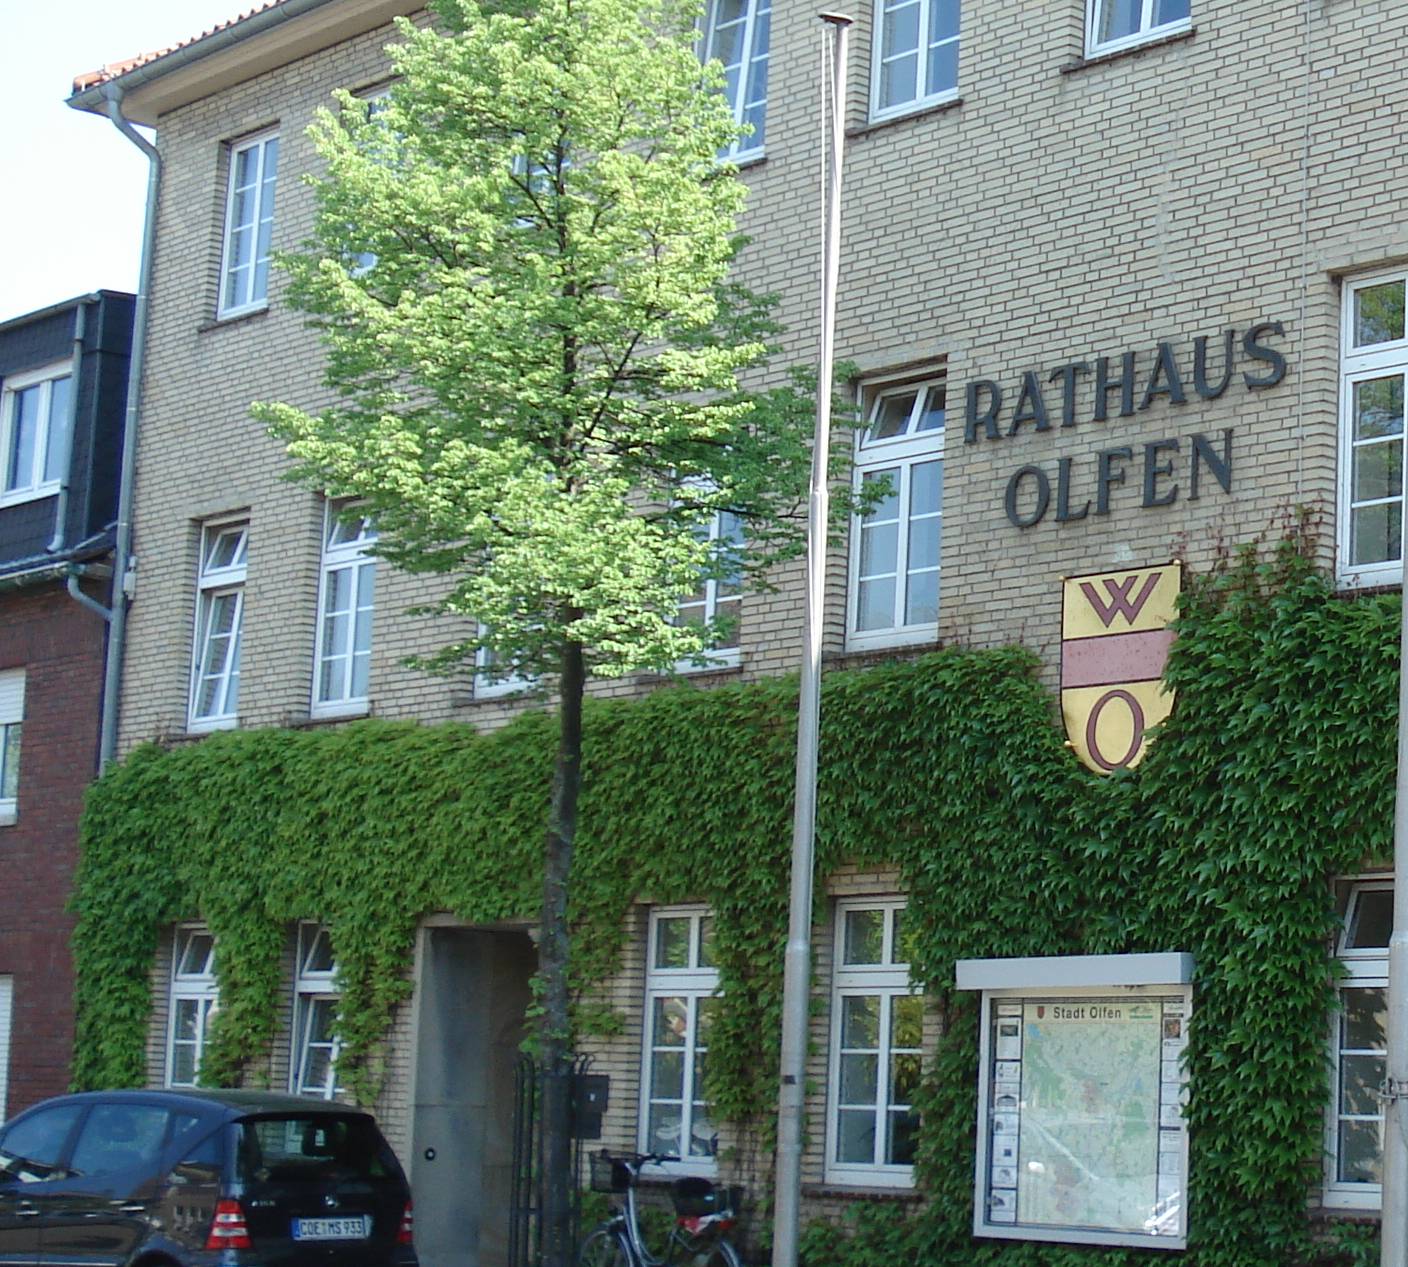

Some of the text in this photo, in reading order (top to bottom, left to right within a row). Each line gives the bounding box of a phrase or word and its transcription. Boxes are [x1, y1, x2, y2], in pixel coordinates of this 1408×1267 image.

[963, 320, 1288, 445] RATHAUS
[1004, 427, 1234, 528] OLFEN
[1079, 572, 1162, 628] W
[1053, 1006, 1121, 1019] Stadt Olfen
[301, 1221, 321, 1235] COE
[343, 1220, 363, 1234] 933
